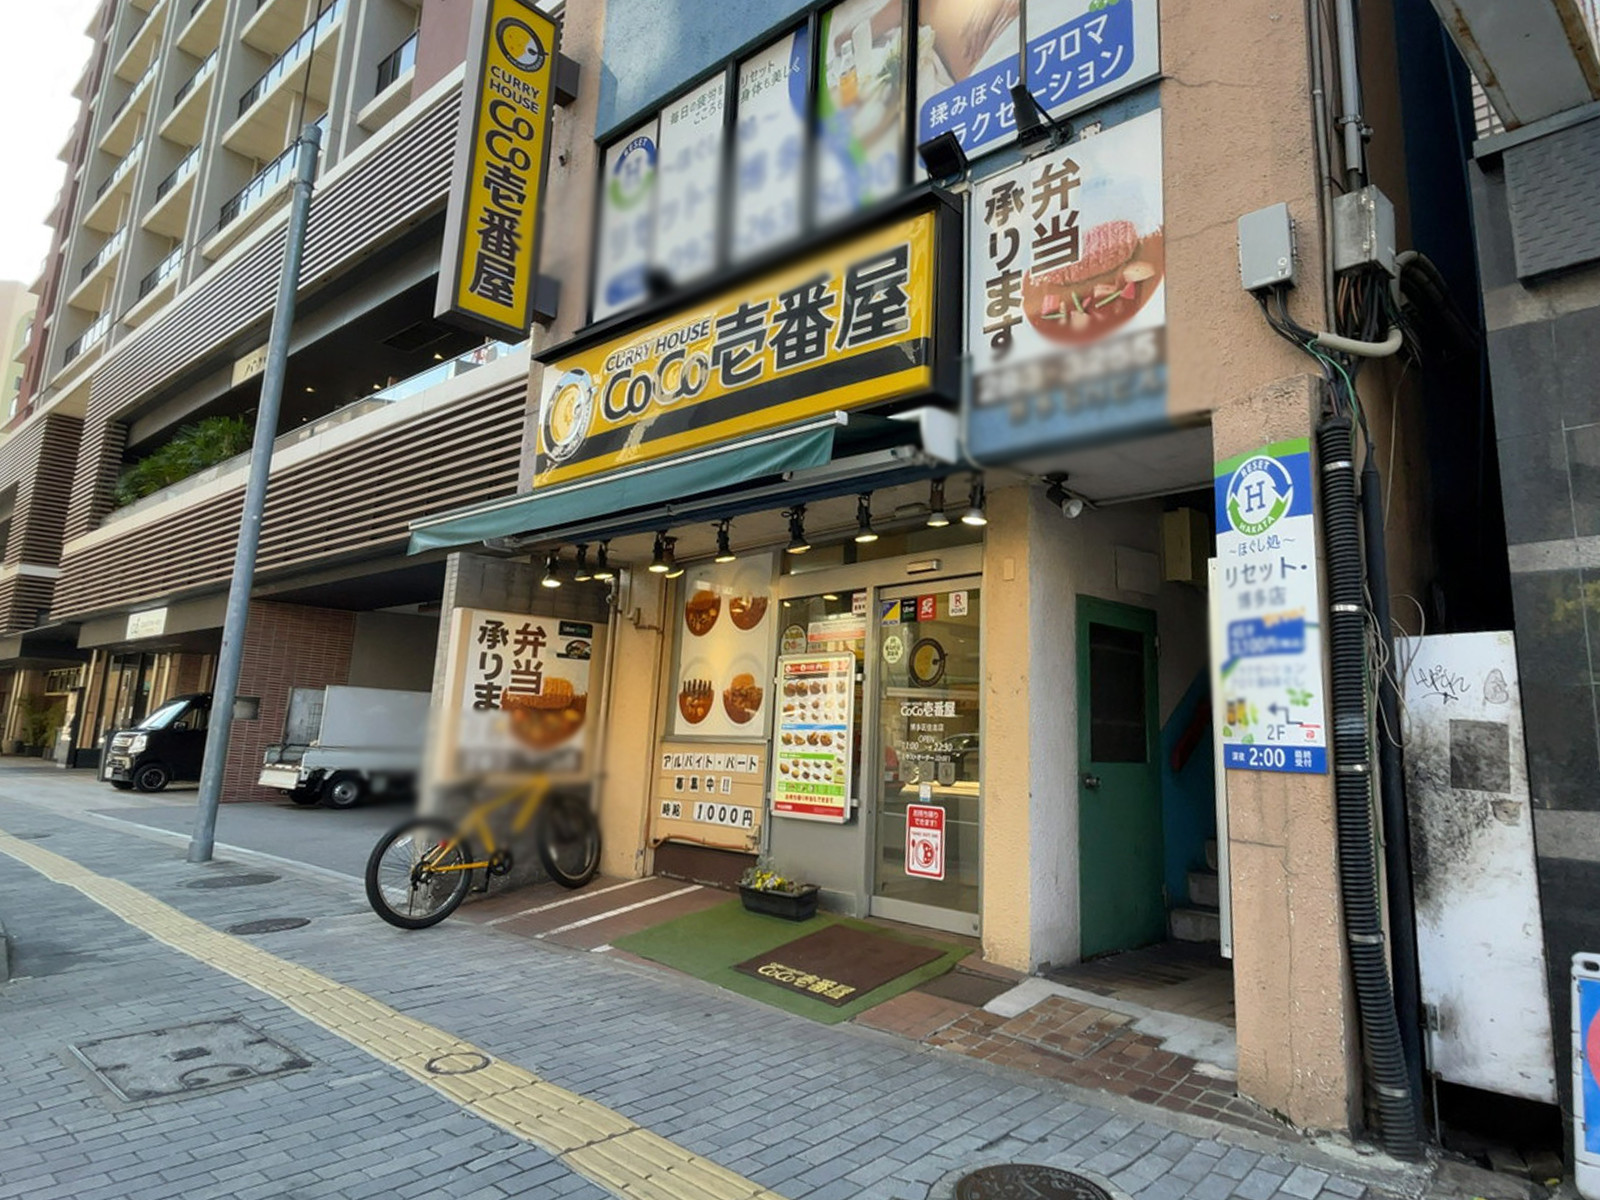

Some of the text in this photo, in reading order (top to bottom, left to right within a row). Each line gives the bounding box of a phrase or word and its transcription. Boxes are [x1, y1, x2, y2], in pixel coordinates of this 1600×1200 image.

[490, 65, 540, 99] CURRY
[929, 14, 1109, 129] 揉みほぐし アロマ
[489, 78, 539, 115] HOUSE
[1031, 158, 1081, 277] 弁当
[982, 179, 1026, 358] 承ります
[602, 243, 911, 422] CoCo壱番屋
[606, 320, 710, 372] CURRY HOUSE
[1241, 460, 1270, 477] RESET
[1245, 481, 1266, 513] H
[1239, 516, 1275, 534] HAKATA
[508, 622, 547, 695] 弁当
[900, 701, 956, 717] CoCo壱番屋
[1267, 724, 1285, 741] 2F
[1249, 747, 1285, 768] 2:00
[697, 804, 753, 827] 1000円
